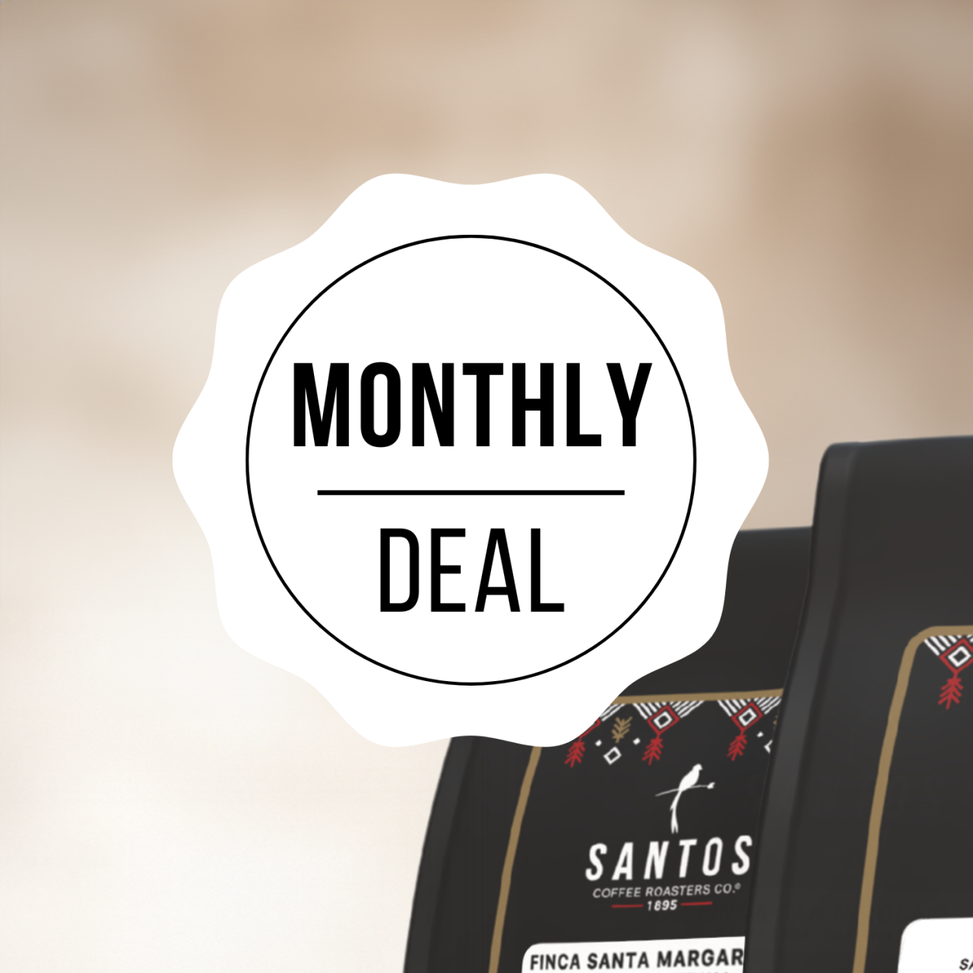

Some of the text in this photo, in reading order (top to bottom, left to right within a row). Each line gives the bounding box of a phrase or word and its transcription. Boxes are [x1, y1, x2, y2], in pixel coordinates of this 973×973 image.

[585, 835, 752, 881] SANTOS
[593, 887, 641, 898] COFFEE
[645, 884, 710, 896] ROASTERS
[648, 899, 677, 911] 1895
[530, 954, 580, 970] FINCA
[587, 952, 649, 970] SANTA
